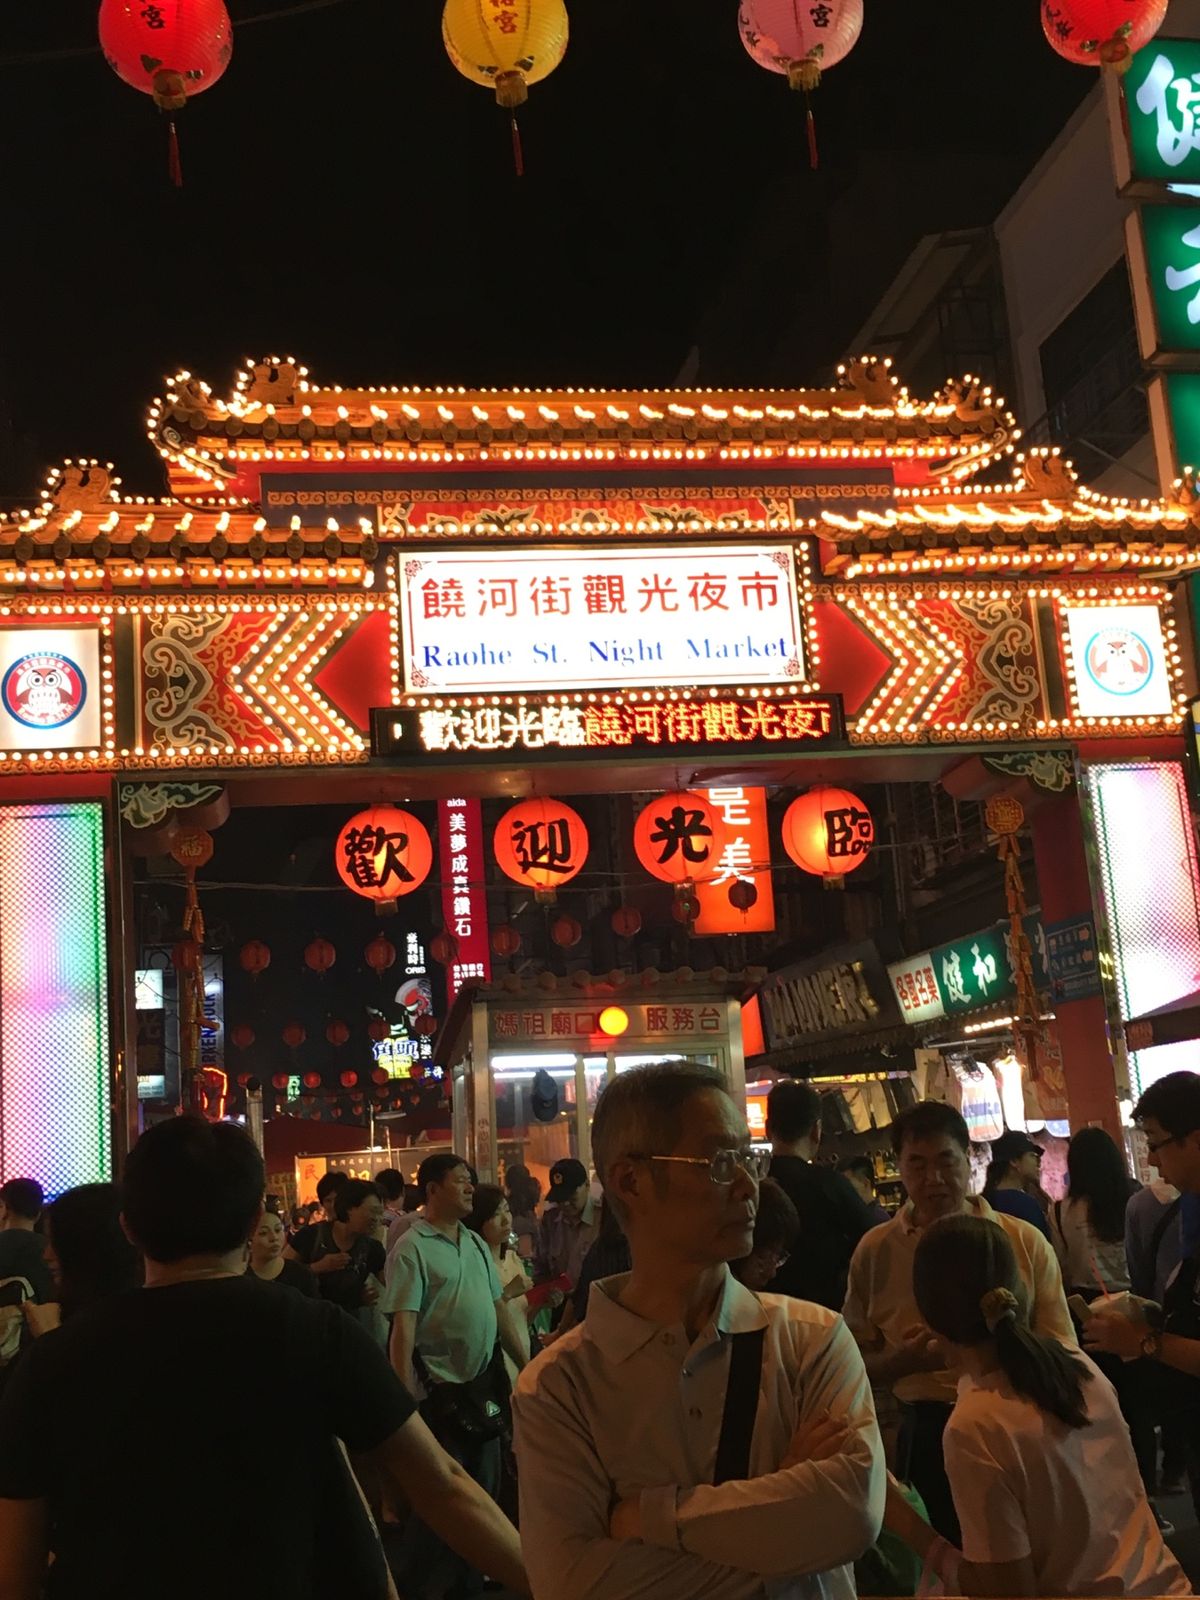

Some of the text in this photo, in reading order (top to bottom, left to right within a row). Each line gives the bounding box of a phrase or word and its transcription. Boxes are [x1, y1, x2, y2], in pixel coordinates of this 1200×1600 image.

[421, 570, 782, 620] 饒河街觀光夜市
[422, 636, 789, 668] Raohe St. Night Market
[447, 798, 467, 807] aida
[345, 826, 414, 888] 歡
[512, 818, 575, 874] 迎
[650, 806, 713, 864] 光
[824, 807, 872, 858] 臨
[449, 812, 472, 937] 美夢成真鑽石
[405, 966, 427, 975] ORIS
[495, 1007, 721, 1036] 媽祖廟口 服務台
